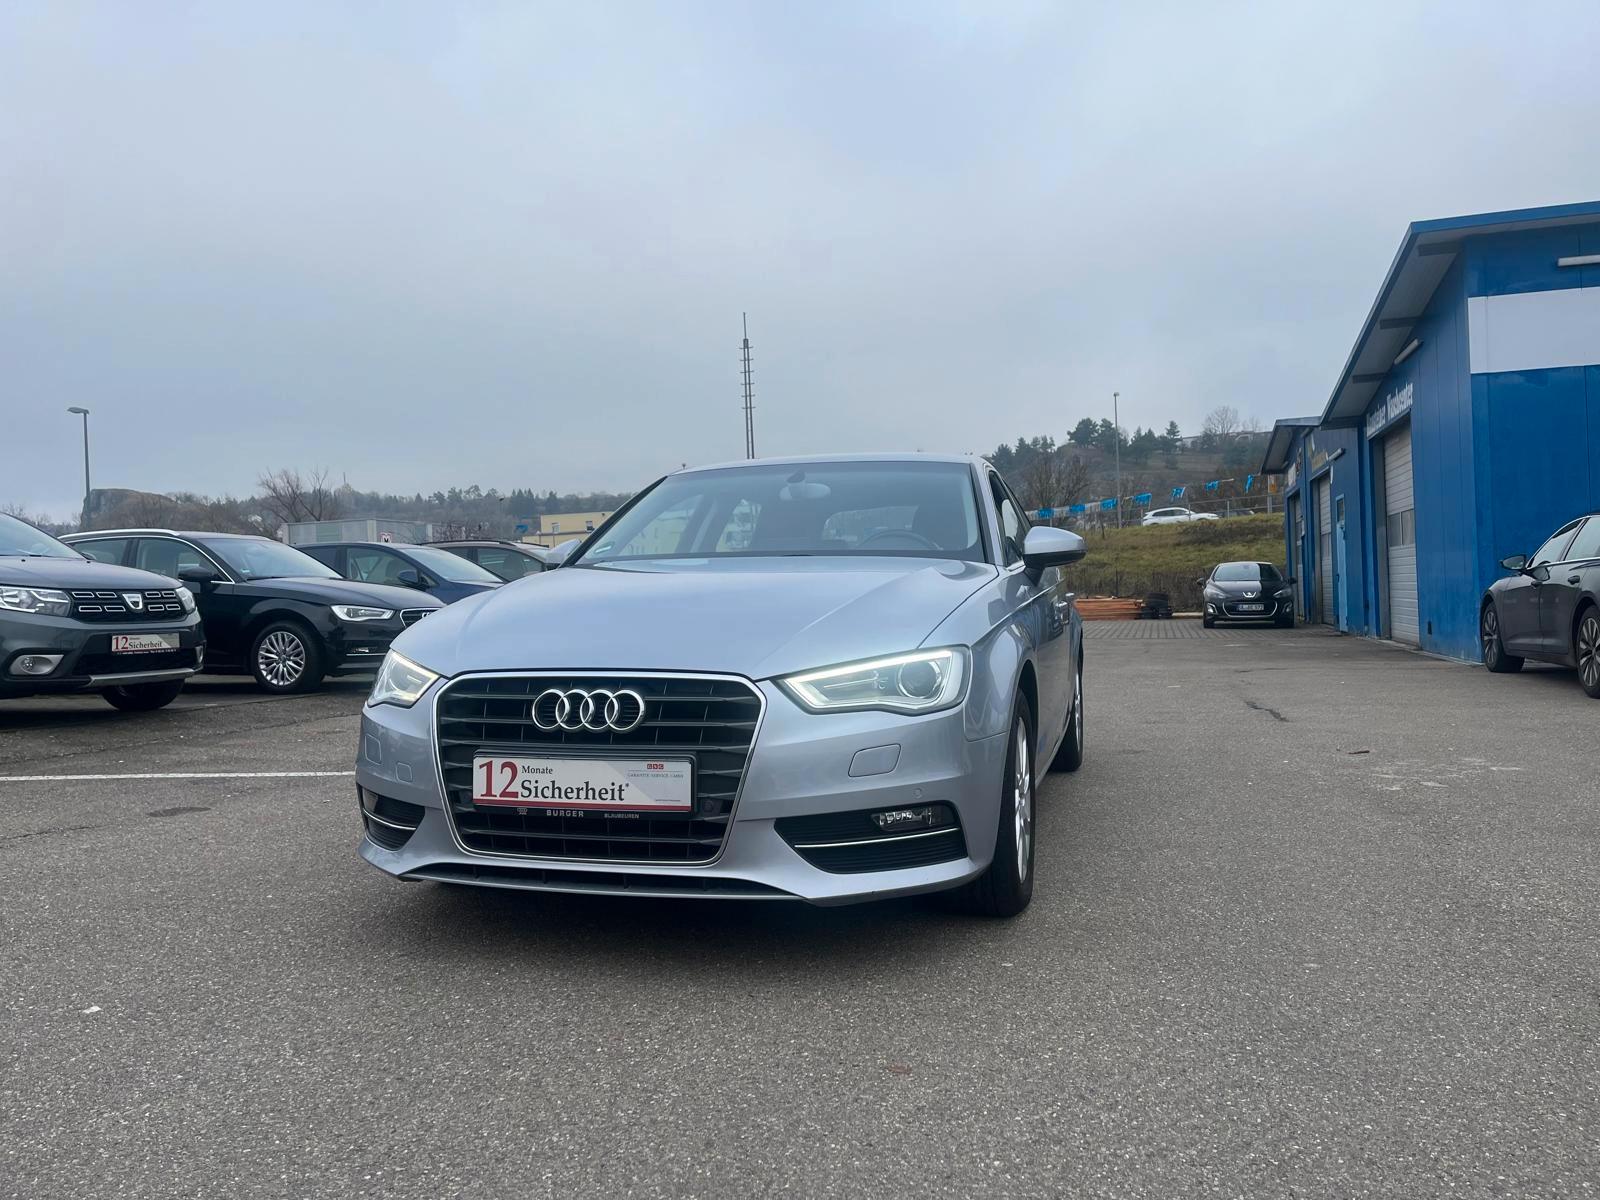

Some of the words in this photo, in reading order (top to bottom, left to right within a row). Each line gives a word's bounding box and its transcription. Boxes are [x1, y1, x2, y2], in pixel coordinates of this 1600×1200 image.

[113, 636, 129, 650] 12
[129, 640, 162, 649] Sicherheit
[521, 765, 553, 774] Monate
[479, 760, 519, 799] 12
[546, 809, 584, 818] BURGER
